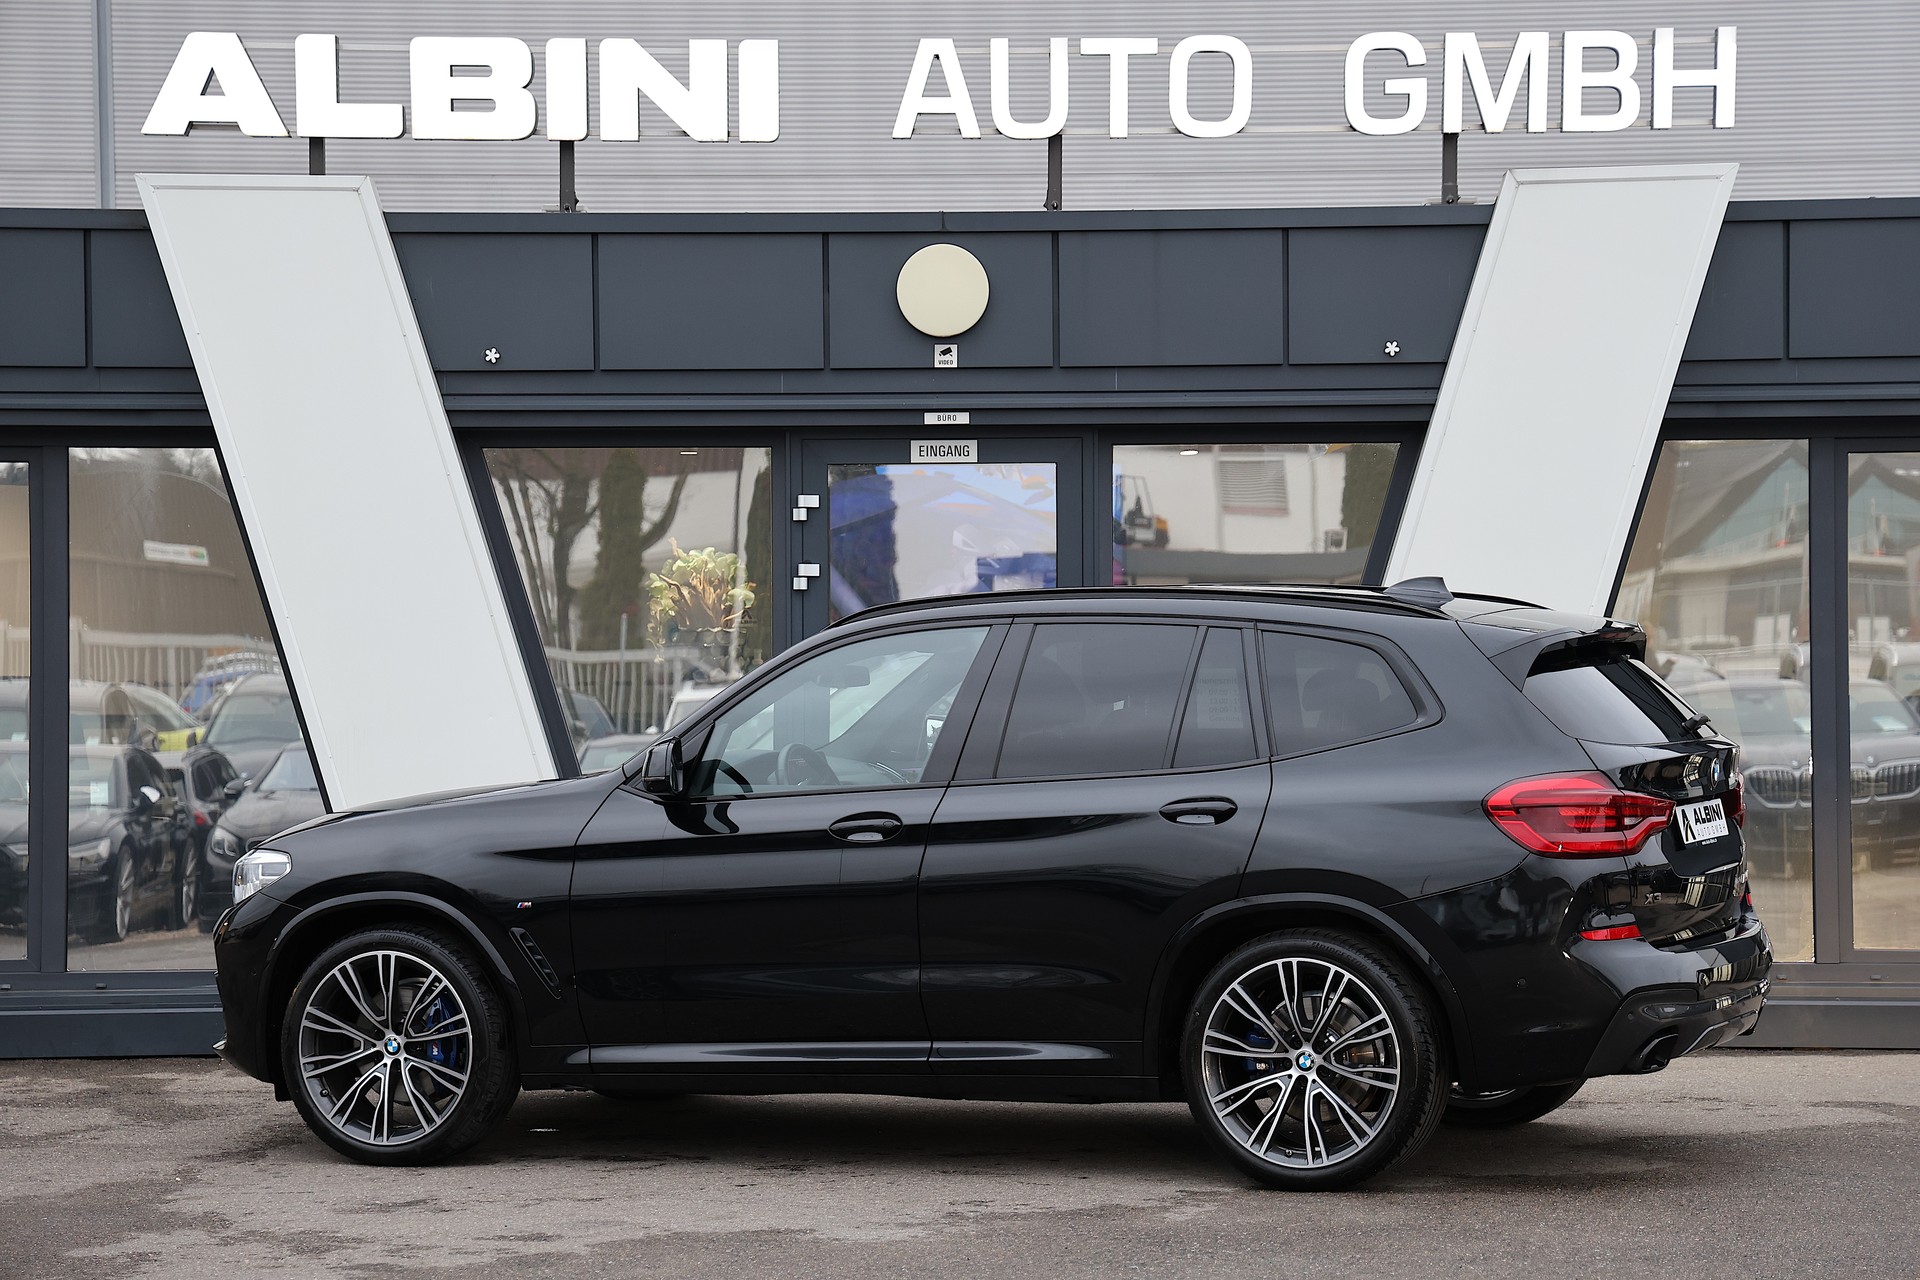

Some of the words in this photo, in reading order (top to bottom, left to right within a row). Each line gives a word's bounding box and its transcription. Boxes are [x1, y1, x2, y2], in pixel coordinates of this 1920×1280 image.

[141, 31, 780, 142] ALBINI
[892, 34, 1253, 139] AUTO
[1343, 26, 1738, 136] GMBH
[937, 414, 957, 422] BÜRO
[918, 444, 970, 457] EINGANG
[1693, 803, 1723, 825] ALBINI
[1645, 892, 1661, 904] X3
